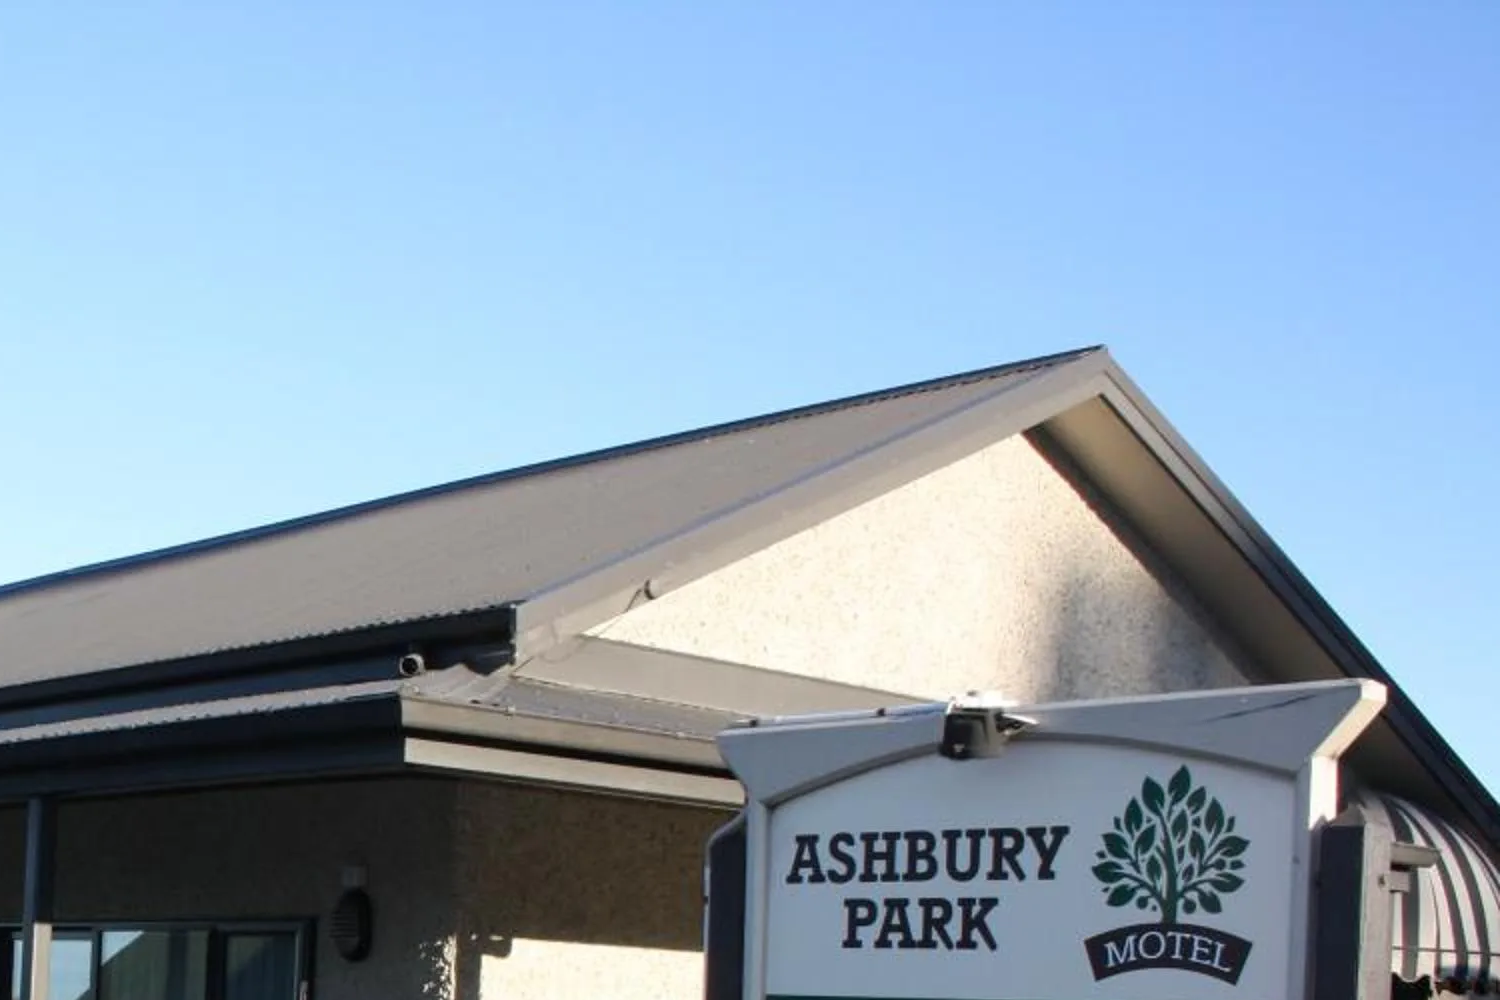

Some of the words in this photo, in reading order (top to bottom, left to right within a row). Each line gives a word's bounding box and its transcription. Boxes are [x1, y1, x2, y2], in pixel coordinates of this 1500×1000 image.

[786, 826, 1069, 884] ASHBURY
[842, 898, 998, 951] PARK
[1103, 931, 1232, 973] MOTEL
